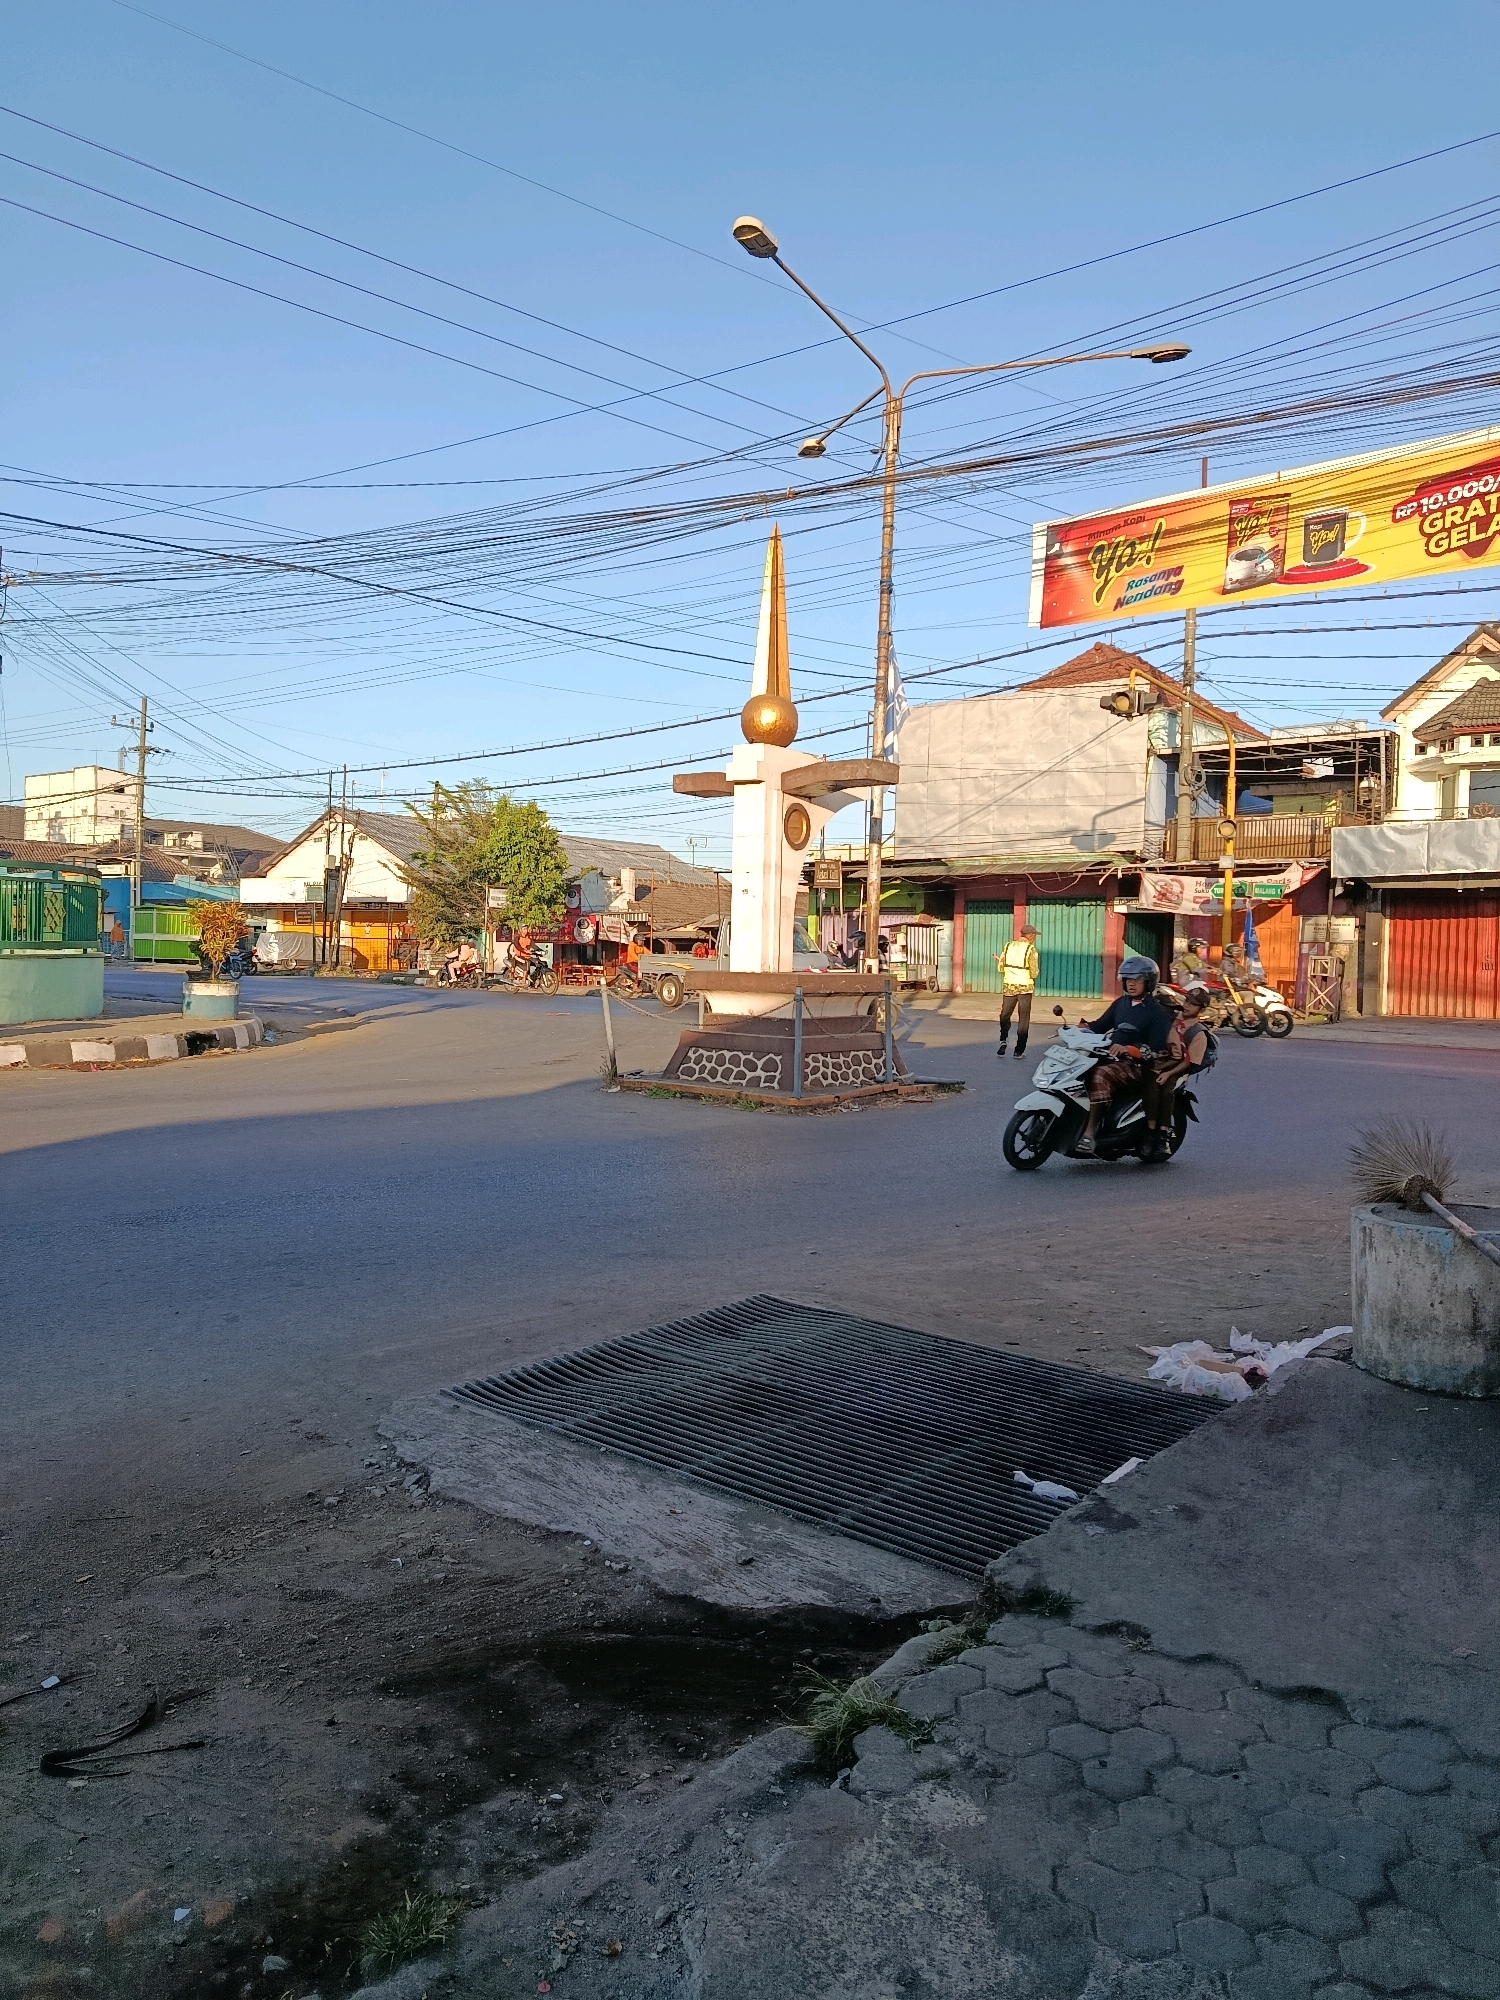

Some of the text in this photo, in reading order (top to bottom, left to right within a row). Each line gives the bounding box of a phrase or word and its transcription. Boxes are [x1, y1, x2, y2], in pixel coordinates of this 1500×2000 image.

[1395, 501, 1418, 520] RP
[1087, 514, 1146, 541] Minum Kopi
[1309, 523, 1323, 531] Kopi
[1125, 564, 1185, 593] Rasanya
[1112, 578, 1185, 612] Nendang
[1255, 887, 1276, 895] MALANG
